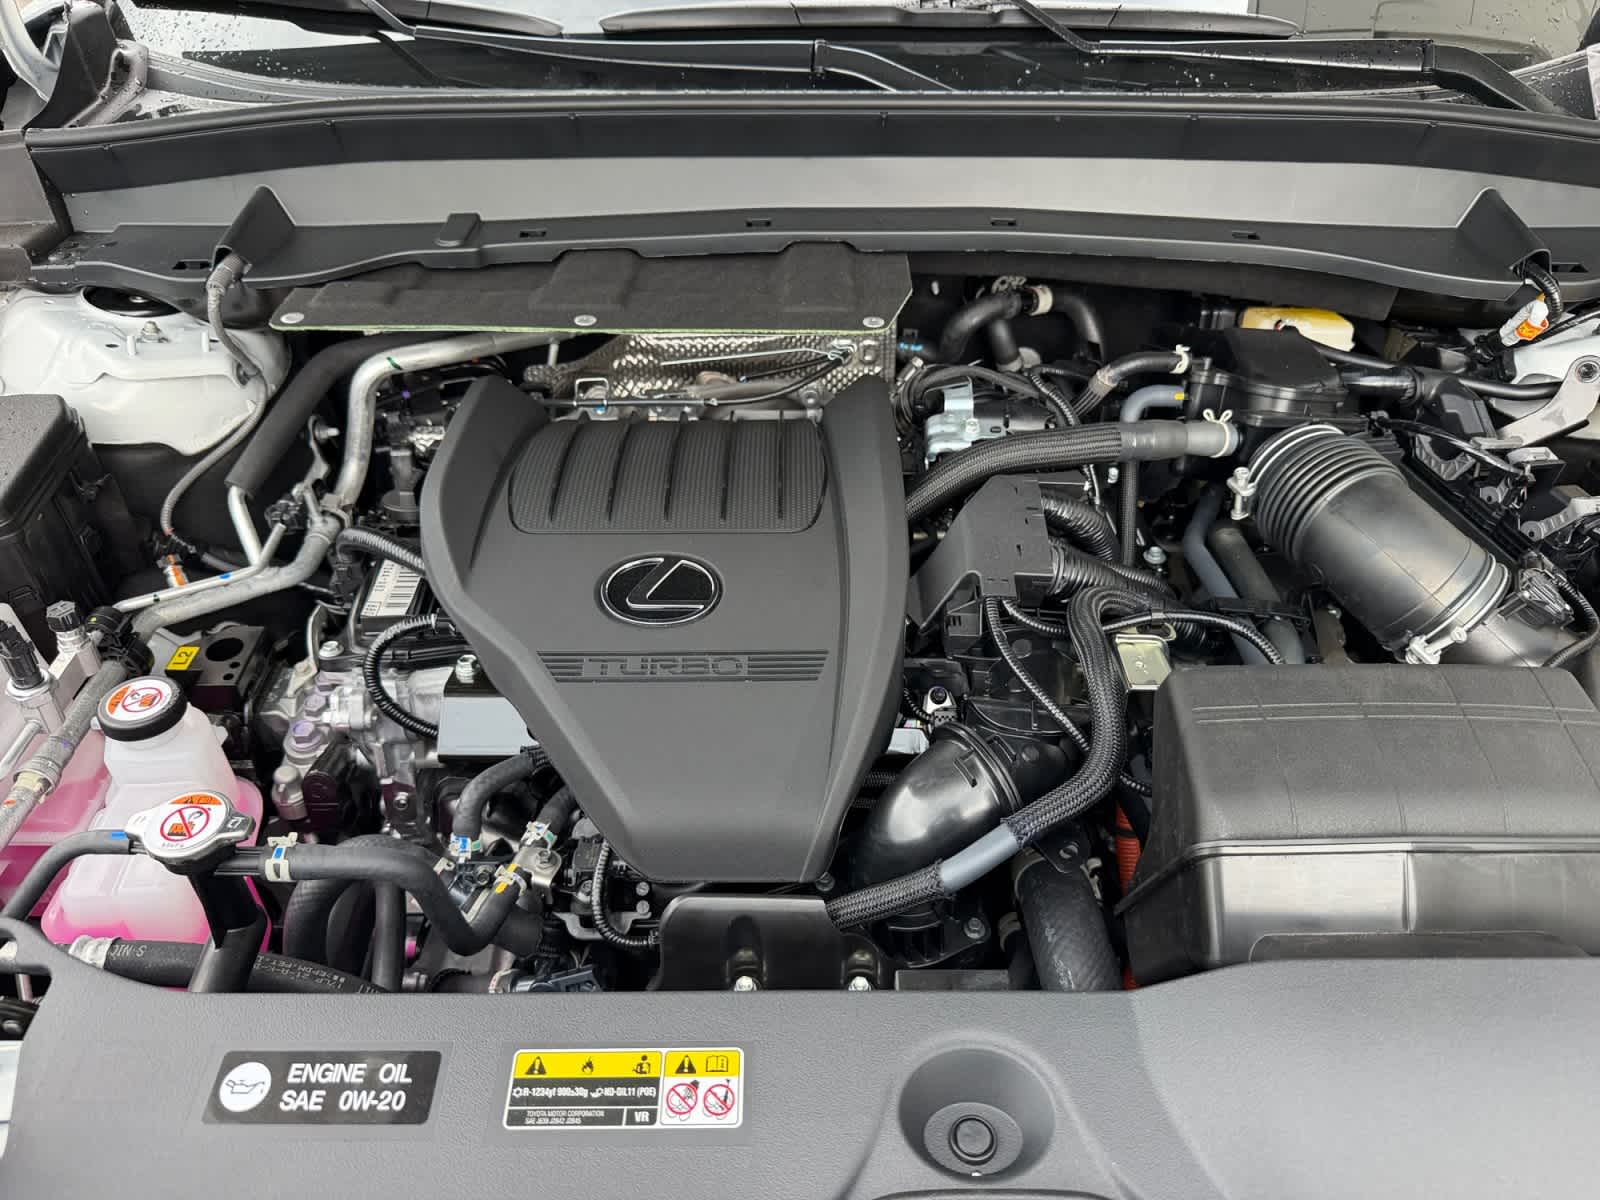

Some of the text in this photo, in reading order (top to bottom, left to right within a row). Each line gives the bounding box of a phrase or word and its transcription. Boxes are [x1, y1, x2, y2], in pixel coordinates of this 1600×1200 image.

[588, 656, 743, 676] TURBO
[287, 1063, 412, 1083] ENGINE OIL
[279, 1089, 406, 1111] SAE 0W-20
[634, 1111, 650, 1122] VR
